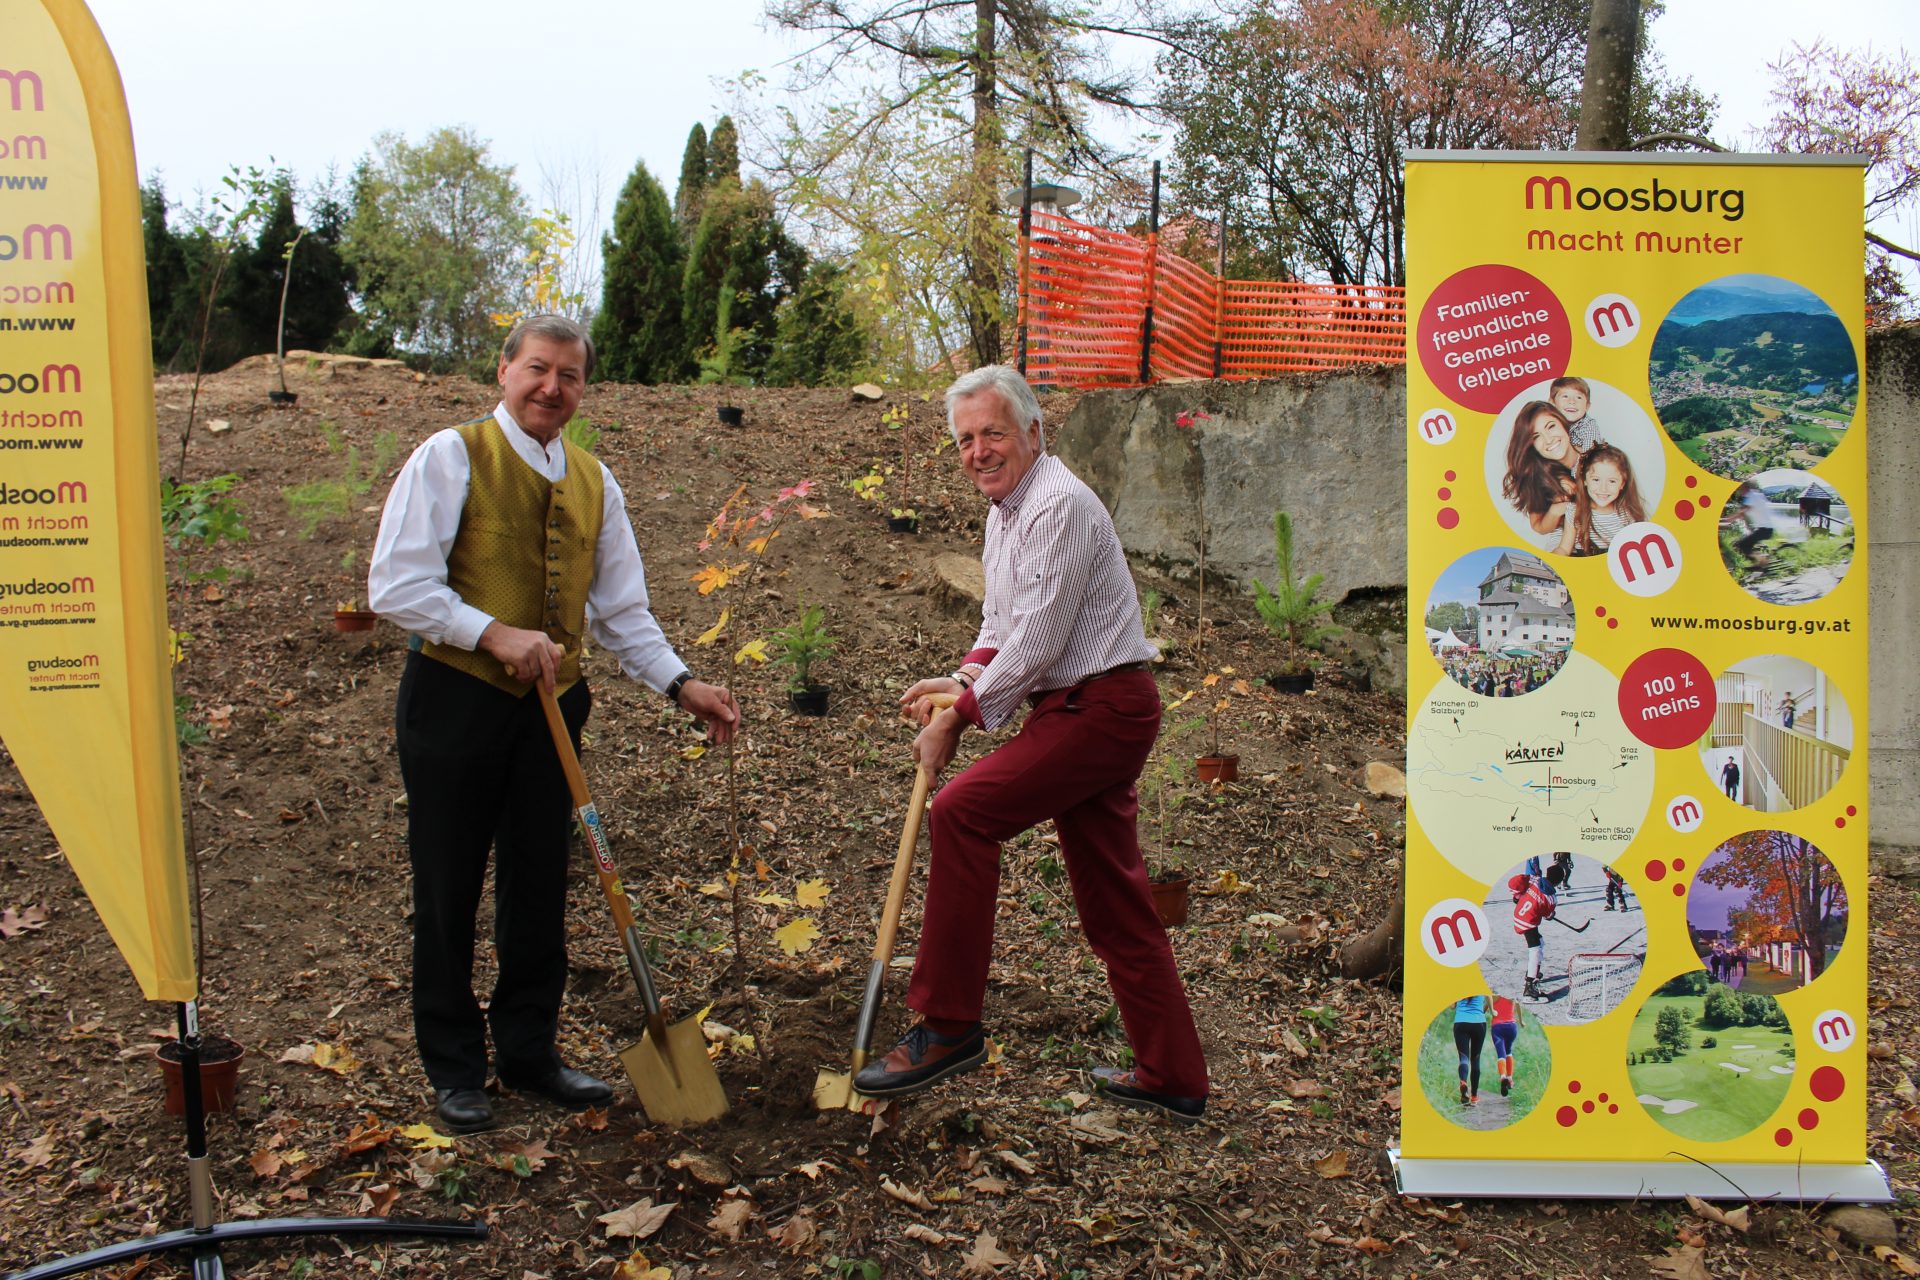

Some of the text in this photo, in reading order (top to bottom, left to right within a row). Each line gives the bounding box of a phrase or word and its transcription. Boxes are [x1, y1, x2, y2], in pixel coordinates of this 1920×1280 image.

[1437, 289, 1530, 322] Familien-
[1432, 309, 1549, 351] freundliche
[1444, 333, 1551, 369] Gemeinde
[1458, 357, 1551, 392] (er)leben
[1650, 616, 1851, 634] www.moosburg.gv.at
[1643, 671, 1694, 698] 100 %
[1430, 707, 1465, 715] Salzburg
[1467, 700, 1479, 708] (D)
[1641, 694, 1700, 721] meins
[1560, 710, 1596, 718] Prag (CZ)
[1492, 825, 1523, 833] Venedig
[1580, 826, 1635, 834] Laibach (SLO)
[1580, 833, 1608, 842] Zagreb
